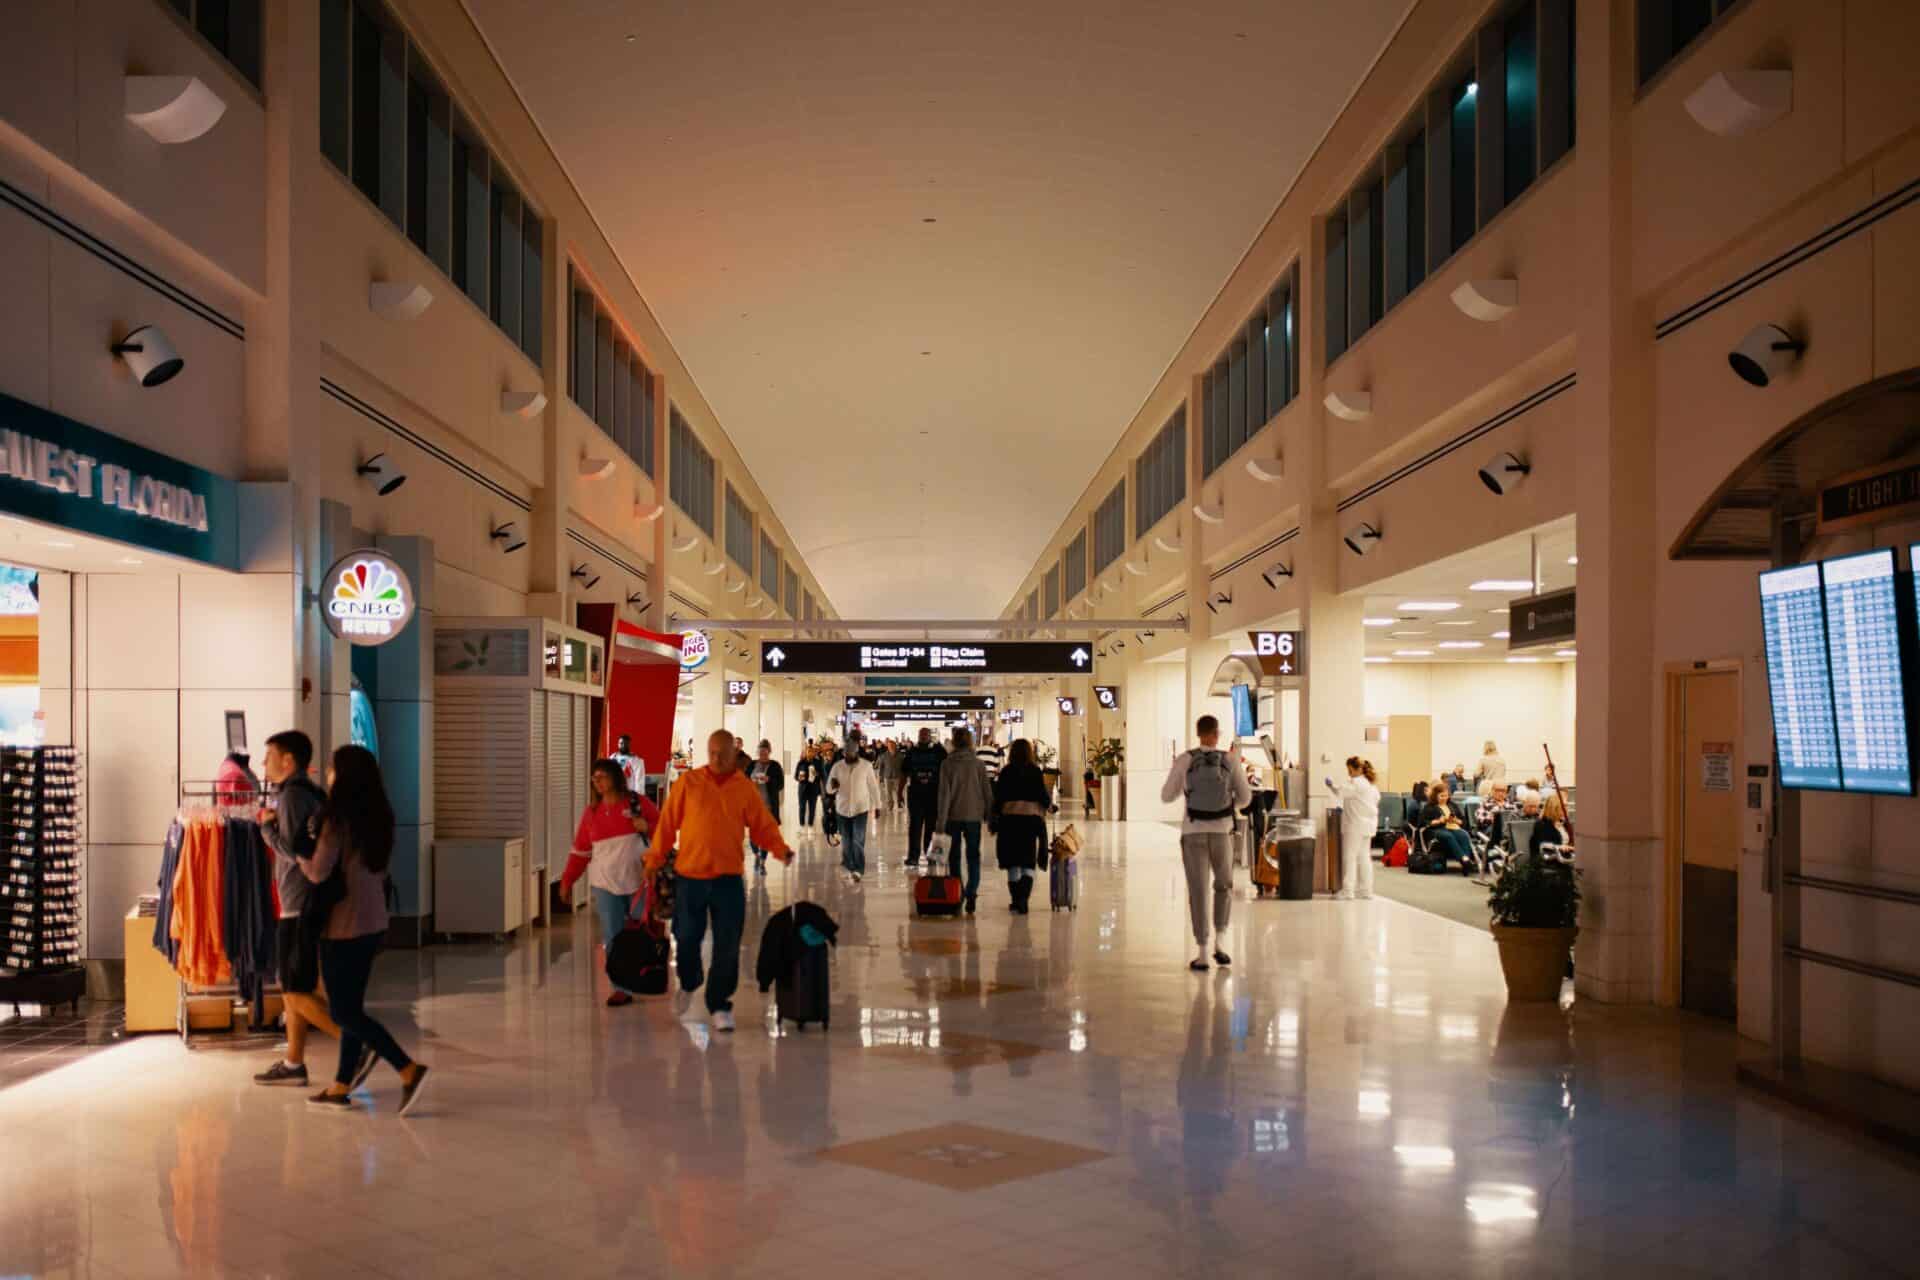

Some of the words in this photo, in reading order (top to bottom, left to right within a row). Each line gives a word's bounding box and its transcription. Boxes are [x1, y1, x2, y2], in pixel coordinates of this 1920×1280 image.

[101, 463, 209, 532] FLORIDA
[331, 601, 402, 617] CNBC
[684, 643, 705, 656] ING
[1257, 633, 1293, 656] B6
[728, 682, 749, 694] B3
